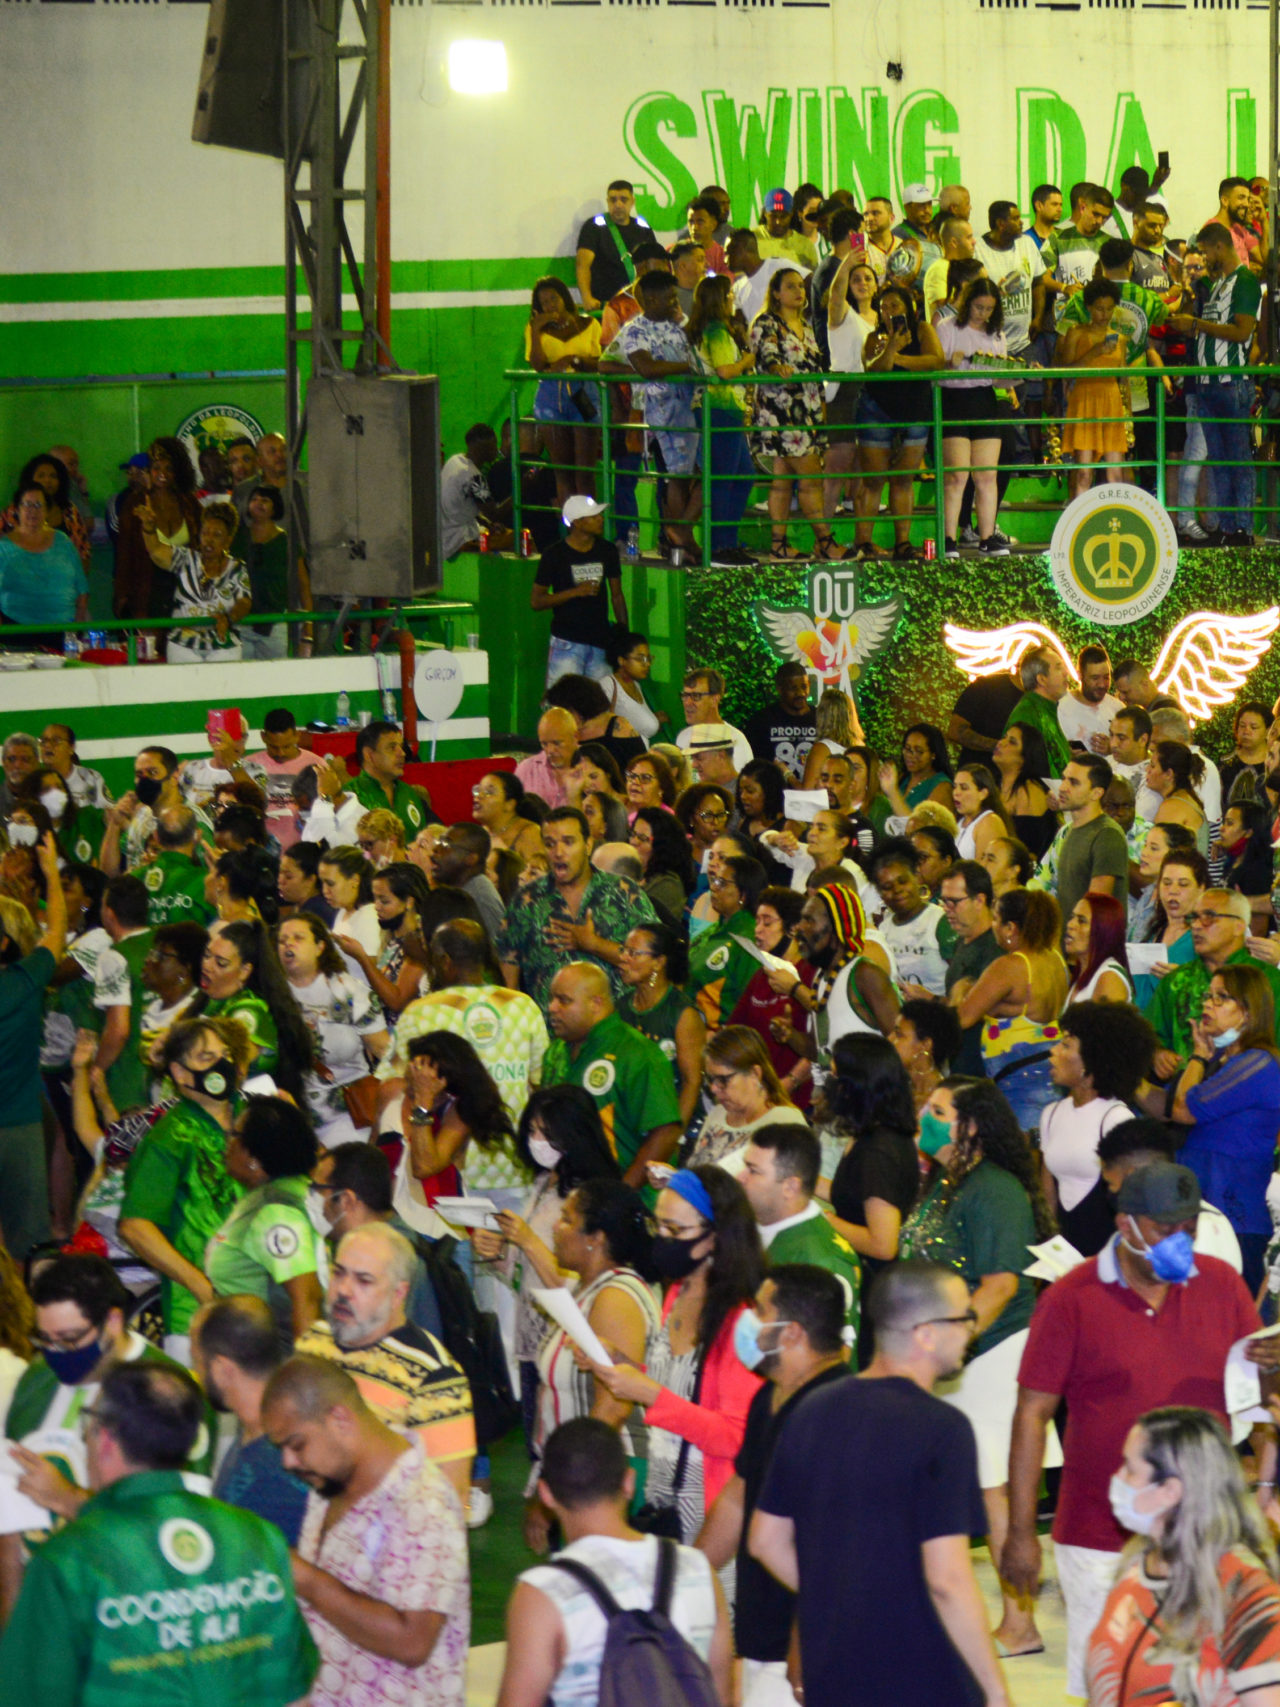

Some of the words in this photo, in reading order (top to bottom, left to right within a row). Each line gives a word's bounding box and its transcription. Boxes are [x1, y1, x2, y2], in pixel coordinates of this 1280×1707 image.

[622, 86, 962, 232] SWING
[1016, 86, 1168, 238] DA
[213, 407, 260, 442] LEOPOLDIN
[1098, 489, 1132, 501] G.R.E.S.
[1056, 569, 1101, 619] IMPERATRIZ
[1102, 567, 1172, 621] LEOPOLDINENSE
[96, 1570, 286, 1630] COORDENAÇÃO
[158, 1619, 193, 1650] DE
